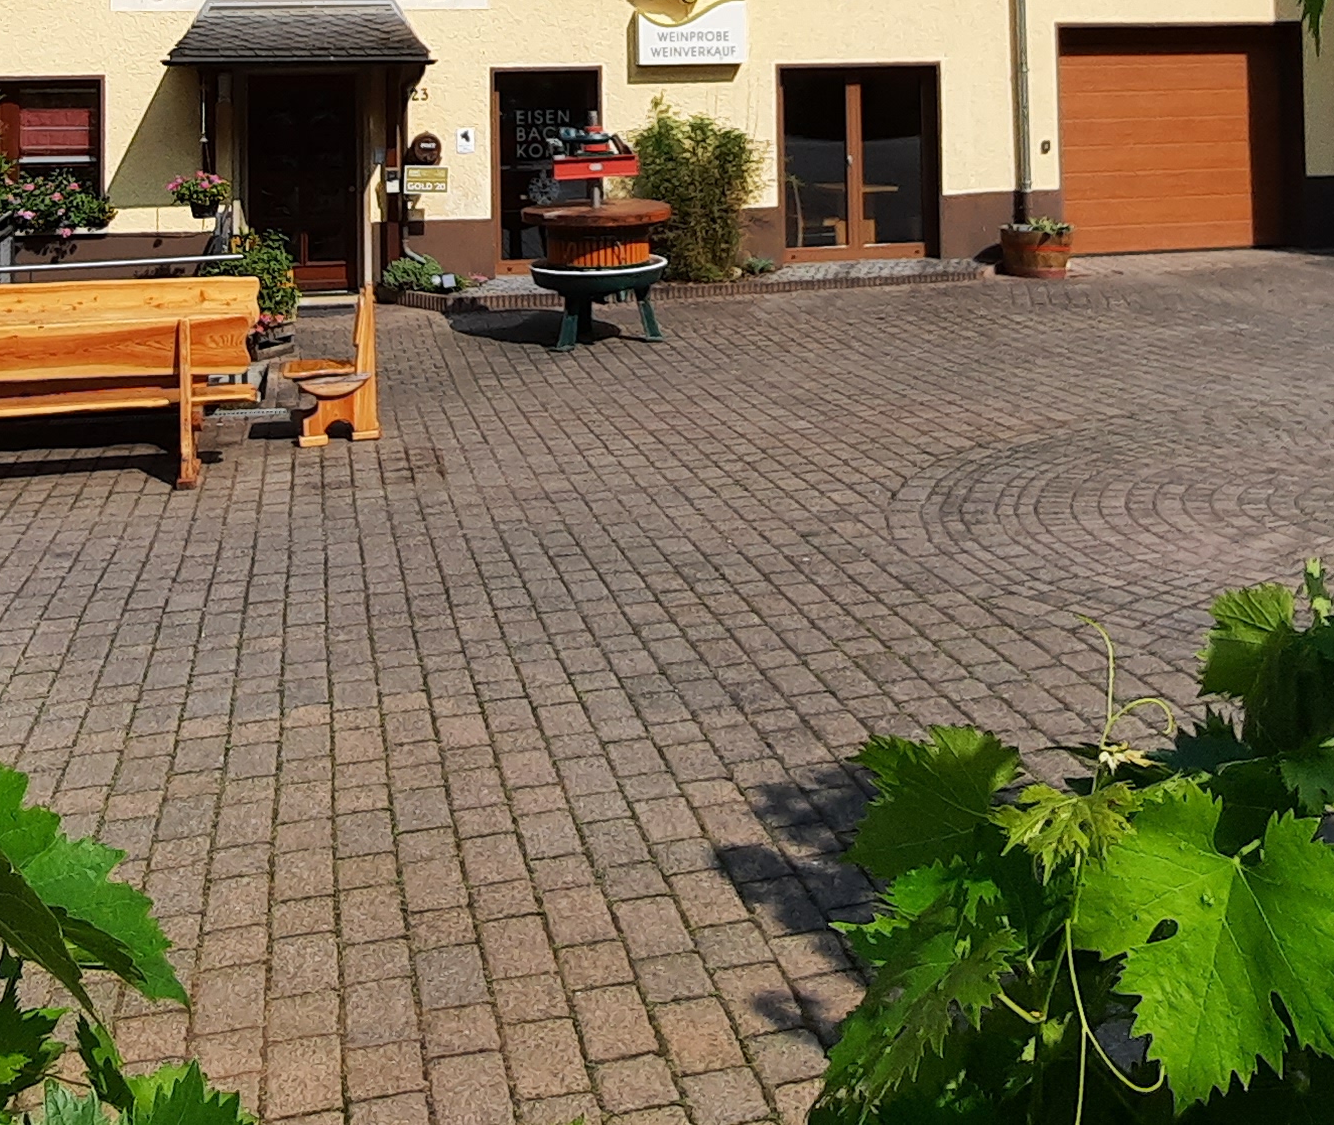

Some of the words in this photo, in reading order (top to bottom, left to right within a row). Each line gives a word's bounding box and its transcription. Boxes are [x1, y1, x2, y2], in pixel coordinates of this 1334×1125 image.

[657, 31, 730, 42] WEINPROBE
[650, 46, 736, 57] WEINVERKAUF
[411, 88, 429, 101] 23
[515, 109, 570, 125] EISEN
[516, 126, 559, 142] BAC
[407, 182, 433, 190] GOLD
